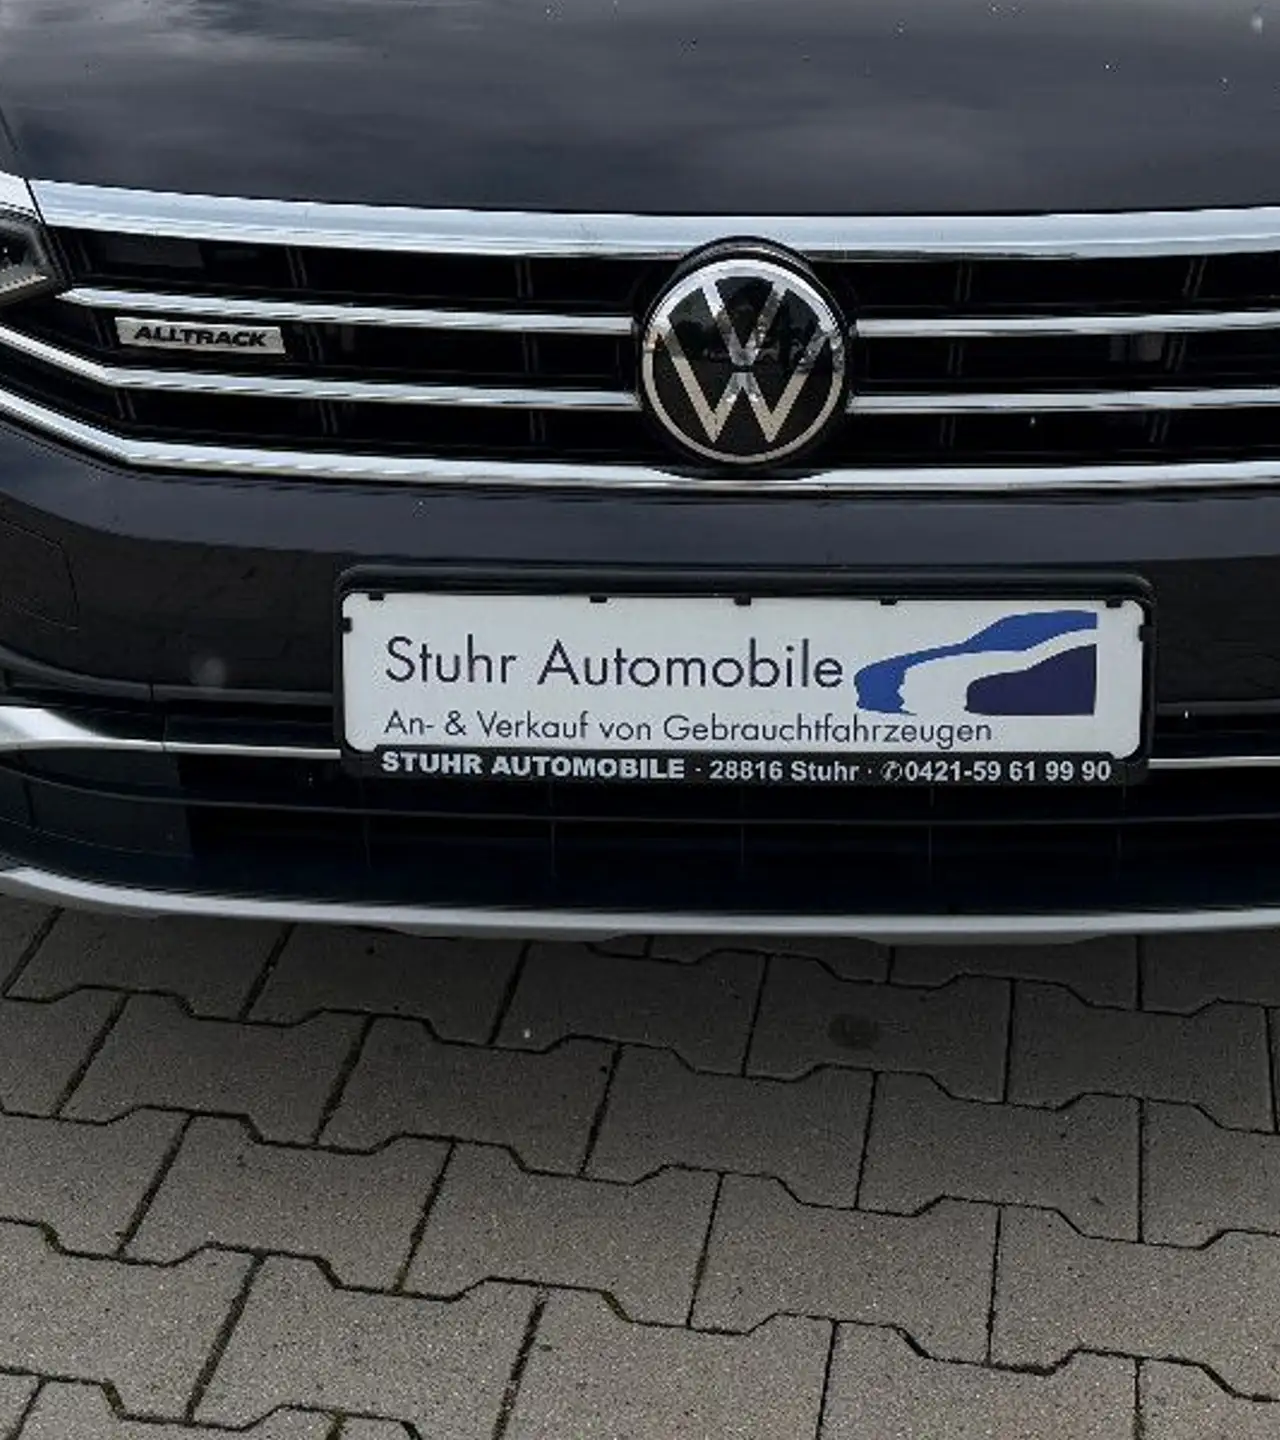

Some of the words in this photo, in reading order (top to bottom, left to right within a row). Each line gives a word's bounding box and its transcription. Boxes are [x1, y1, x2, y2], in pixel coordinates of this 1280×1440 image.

[133, 325, 269, 348] ALLTRACK
[384, 633, 517, 683] Stuhr
[536, 636, 844, 688] Automobile
[383, 709, 435, 737] An-
[444, 710, 468, 737] &
[477, 710, 589, 740] Verkauf
[599, 721, 652, 741] von
[663, 712, 993, 750] Gebrauchtfahrzeugen
[381, 750, 484, 776] STUHR
[490, 755, 686, 780] AUTOMOBILE
[709, 760, 783, 781] 28816
[790, 760, 860, 782] Stuhr
[1008, 761, 1037, 782] 61
[1044, 761, 1075, 782] 99
[1081, 761, 1113, 782] 90
